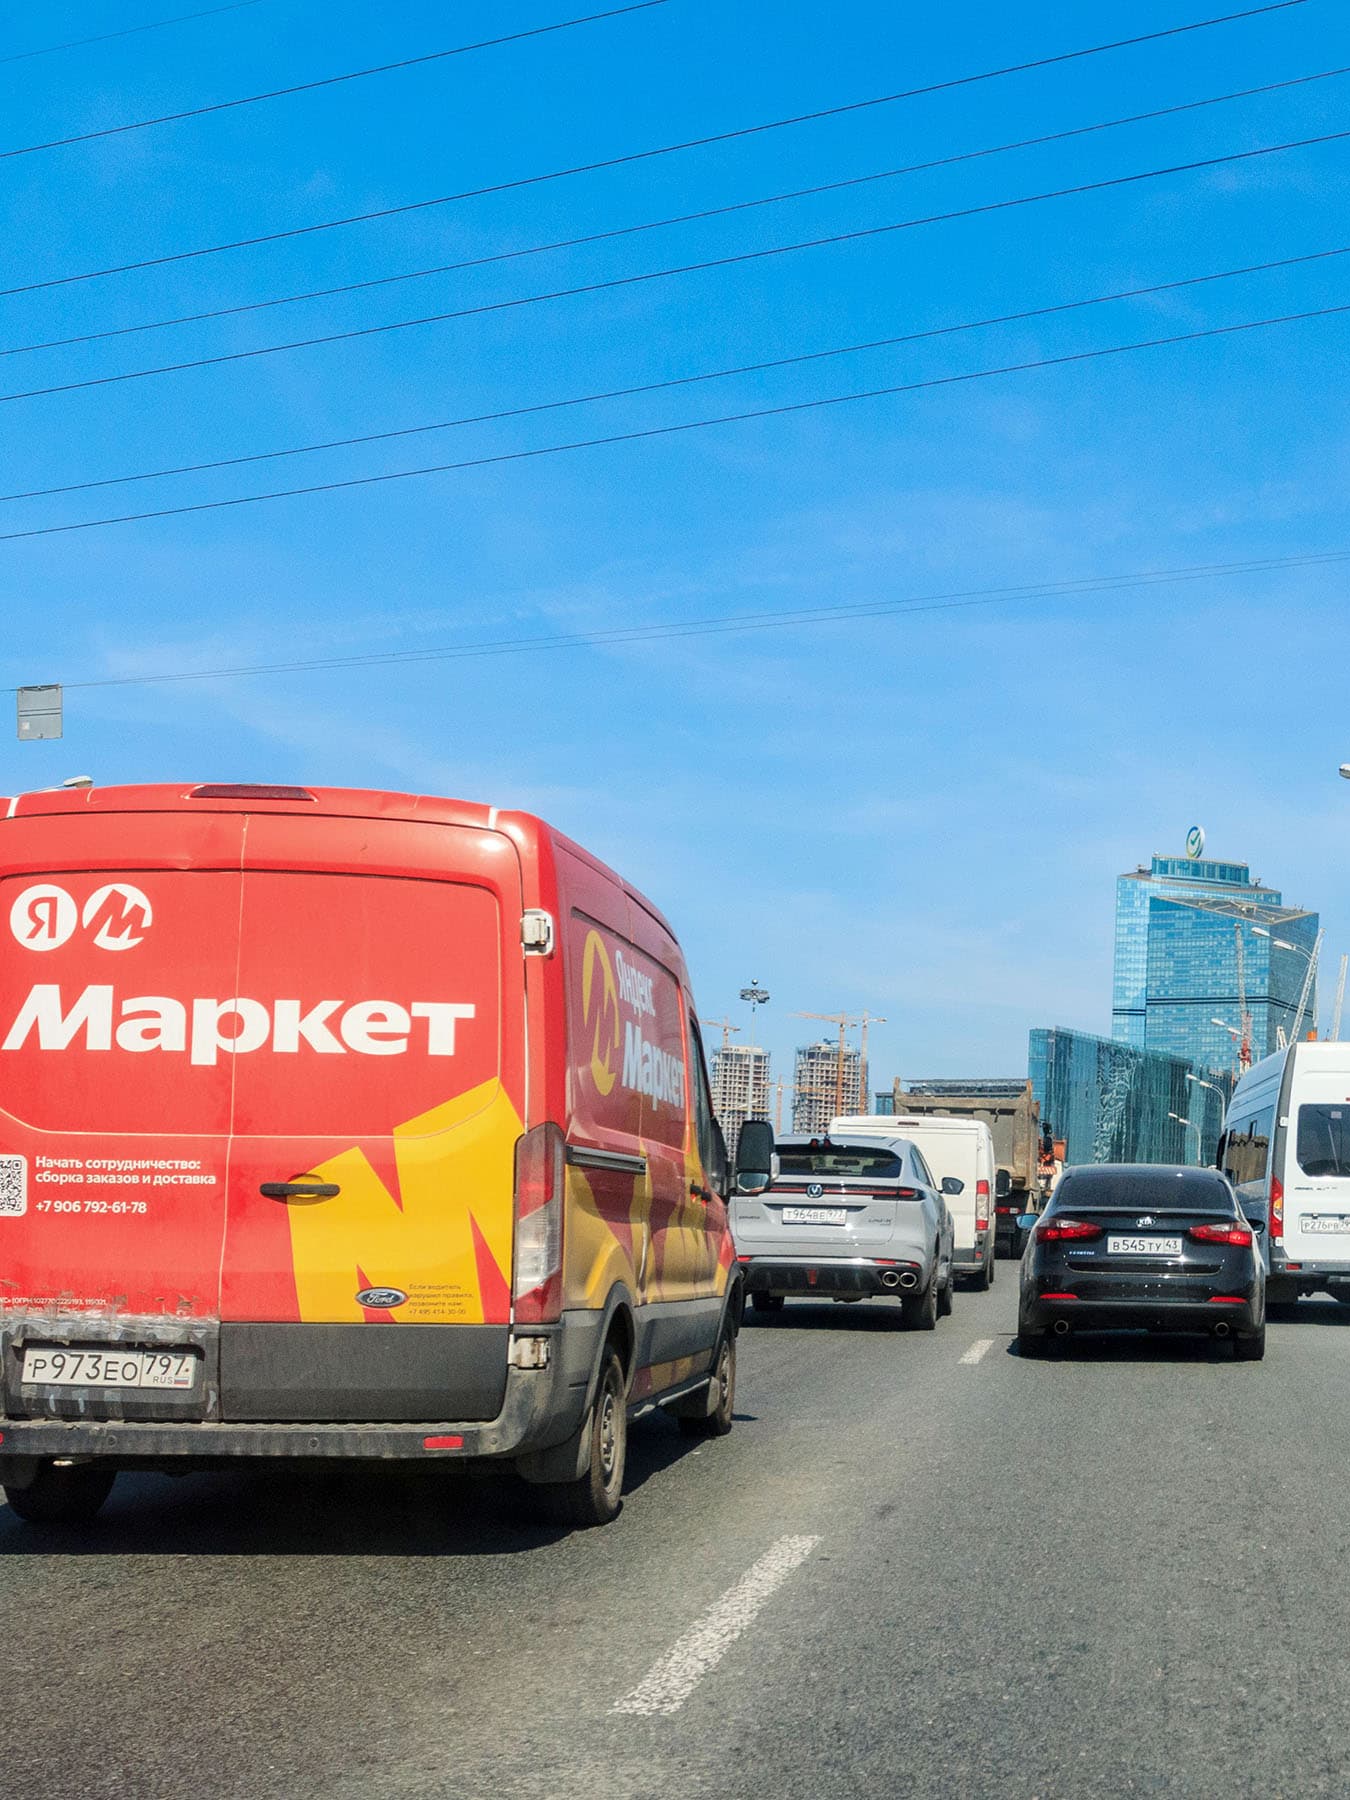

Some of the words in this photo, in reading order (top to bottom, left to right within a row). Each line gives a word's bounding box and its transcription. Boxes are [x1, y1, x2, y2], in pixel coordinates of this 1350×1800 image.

[615, 950, 656, 1017] Яндекс
[1, 984, 476, 1066] Маркет
[35, 1156, 83, 1169] Начать
[85, 1158, 201, 1171] сотрудничество:
[35, 1171, 84, 1185] сборка
[86, 1173, 140, 1184] заказов
[142, 1175, 151, 1184] и
[153, 1174, 217, 1185] доставка
[36, 1201, 51, 1212] +7
[54, 1200, 81, 1213] 906
[84, 1201, 148, 1214] 792-61-78
[1112, 1239, 1161, 1252] В545ТУ
[1165, 1239, 1178, 1249] 43
[366, 1291, 395, 1304] Ford
[31, 1353, 139, 1381] Р973ЕО
[144, 1354, 188, 1377] 797
[152, 1376, 174, 1385] RUS
